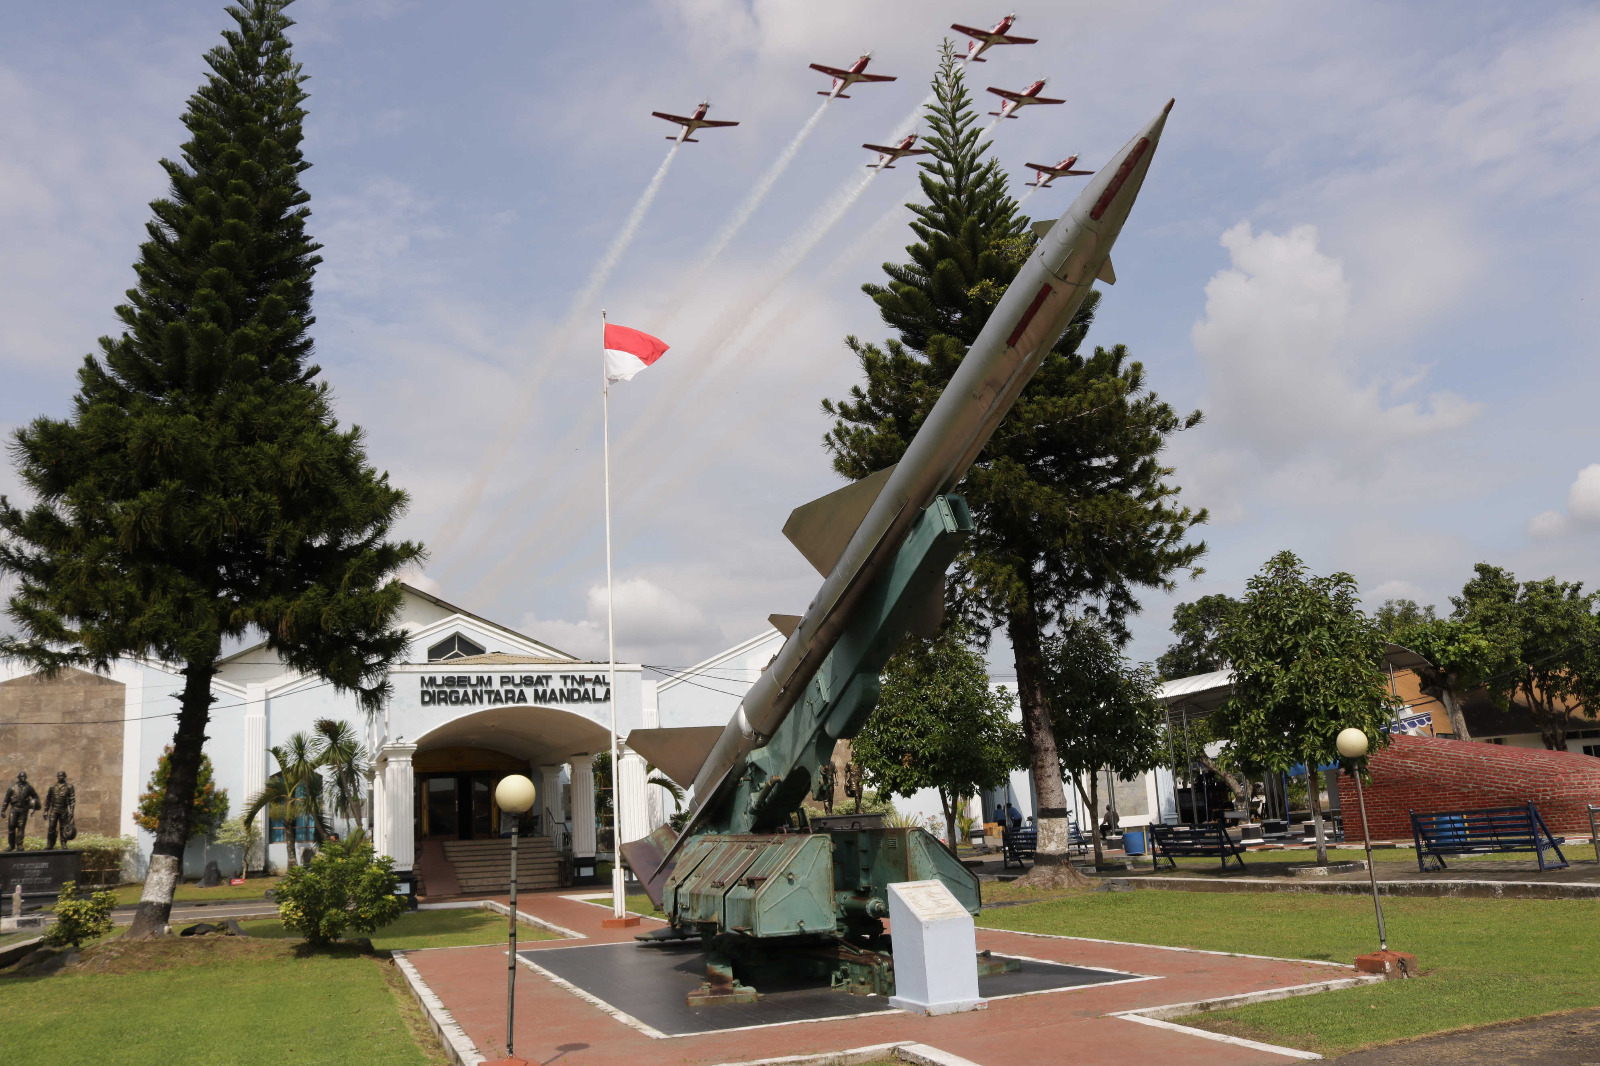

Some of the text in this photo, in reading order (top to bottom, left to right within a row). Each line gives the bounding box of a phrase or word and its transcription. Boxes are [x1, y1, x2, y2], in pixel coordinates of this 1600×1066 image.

[420, 676, 492, 688] MUSEUM
[500, 675, 552, 686] PUSAT
[420, 688, 610, 706] DIRGANTARA MANDALA
